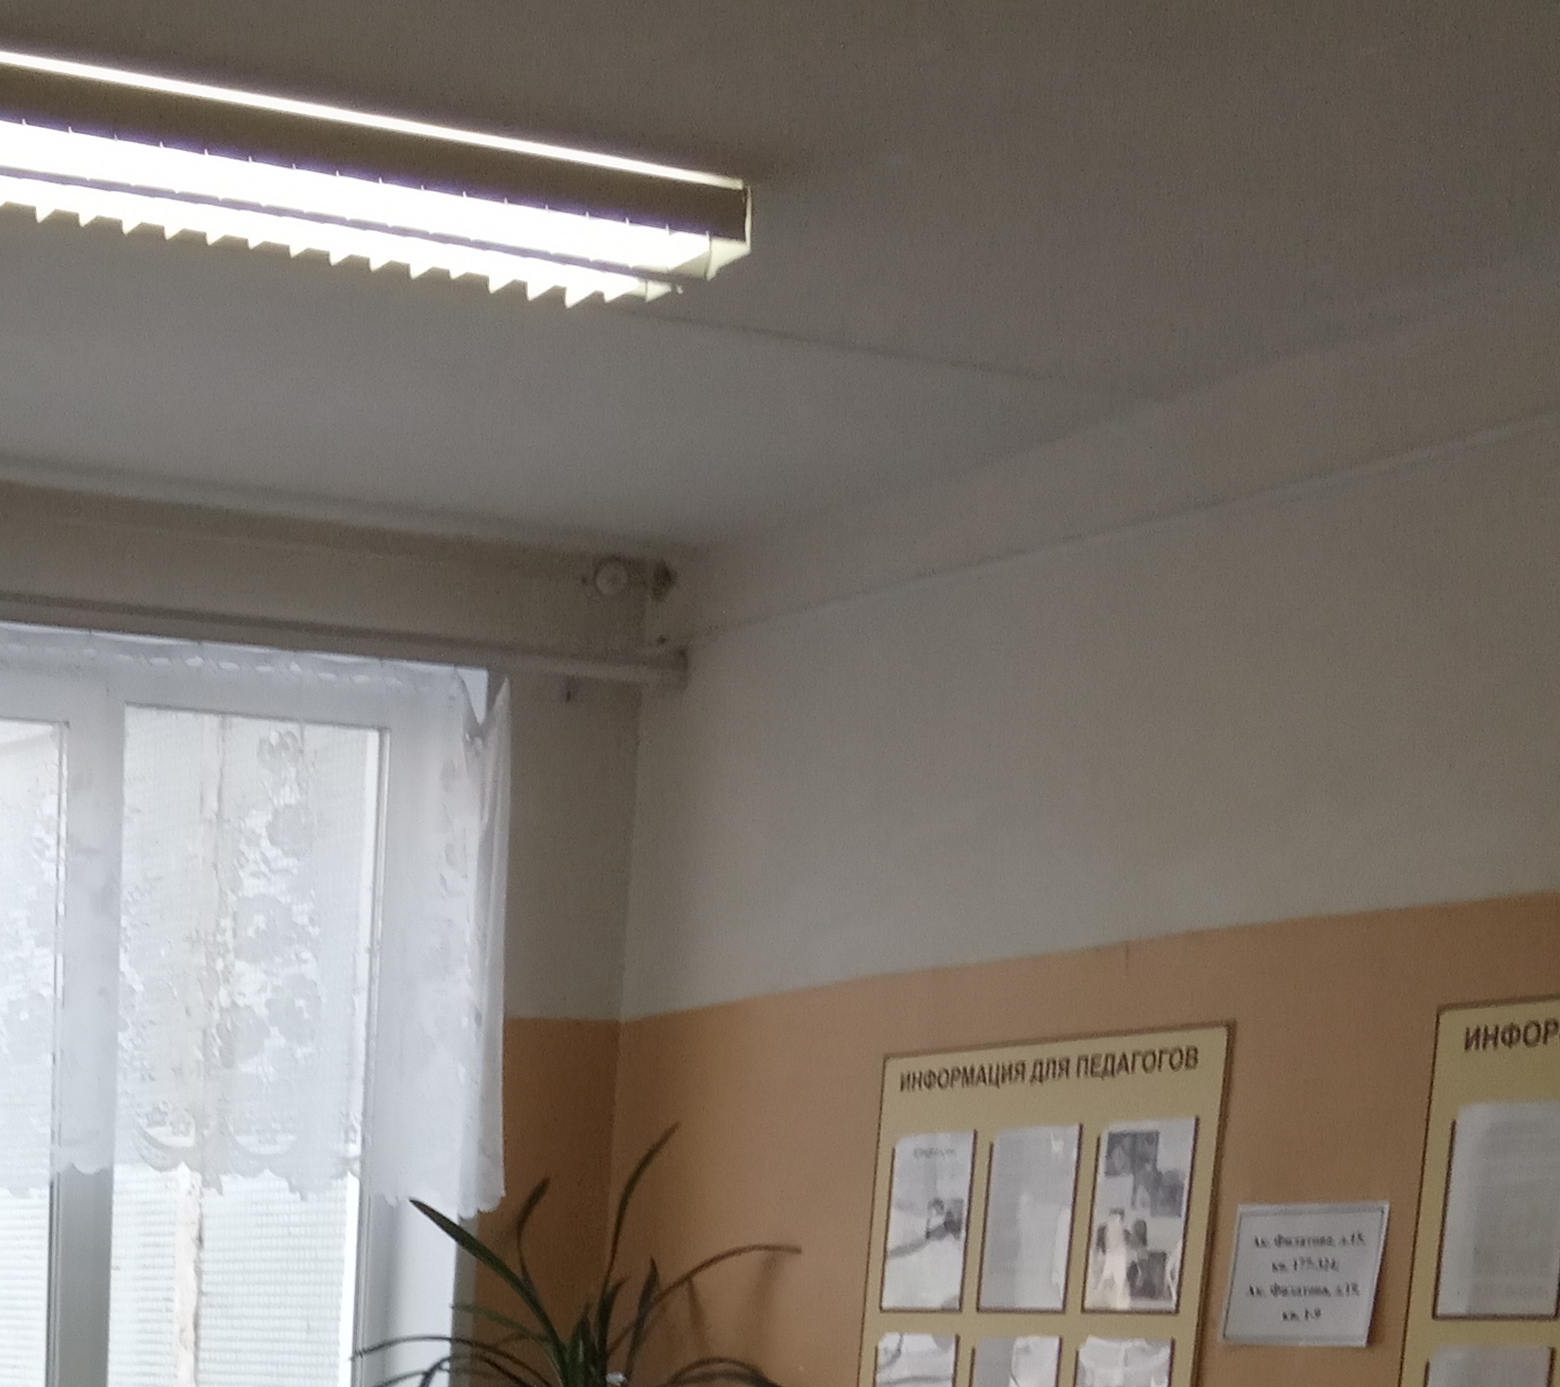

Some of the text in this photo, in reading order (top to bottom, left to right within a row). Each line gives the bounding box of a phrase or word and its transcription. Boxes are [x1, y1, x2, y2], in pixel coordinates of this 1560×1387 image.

[1464, 1016, 1560, 1052] ИНФОР
[899, 1045, 1199, 1092] ИНФОРМАЦИЯ ДЛЯ ПЕДАГОГОВ
